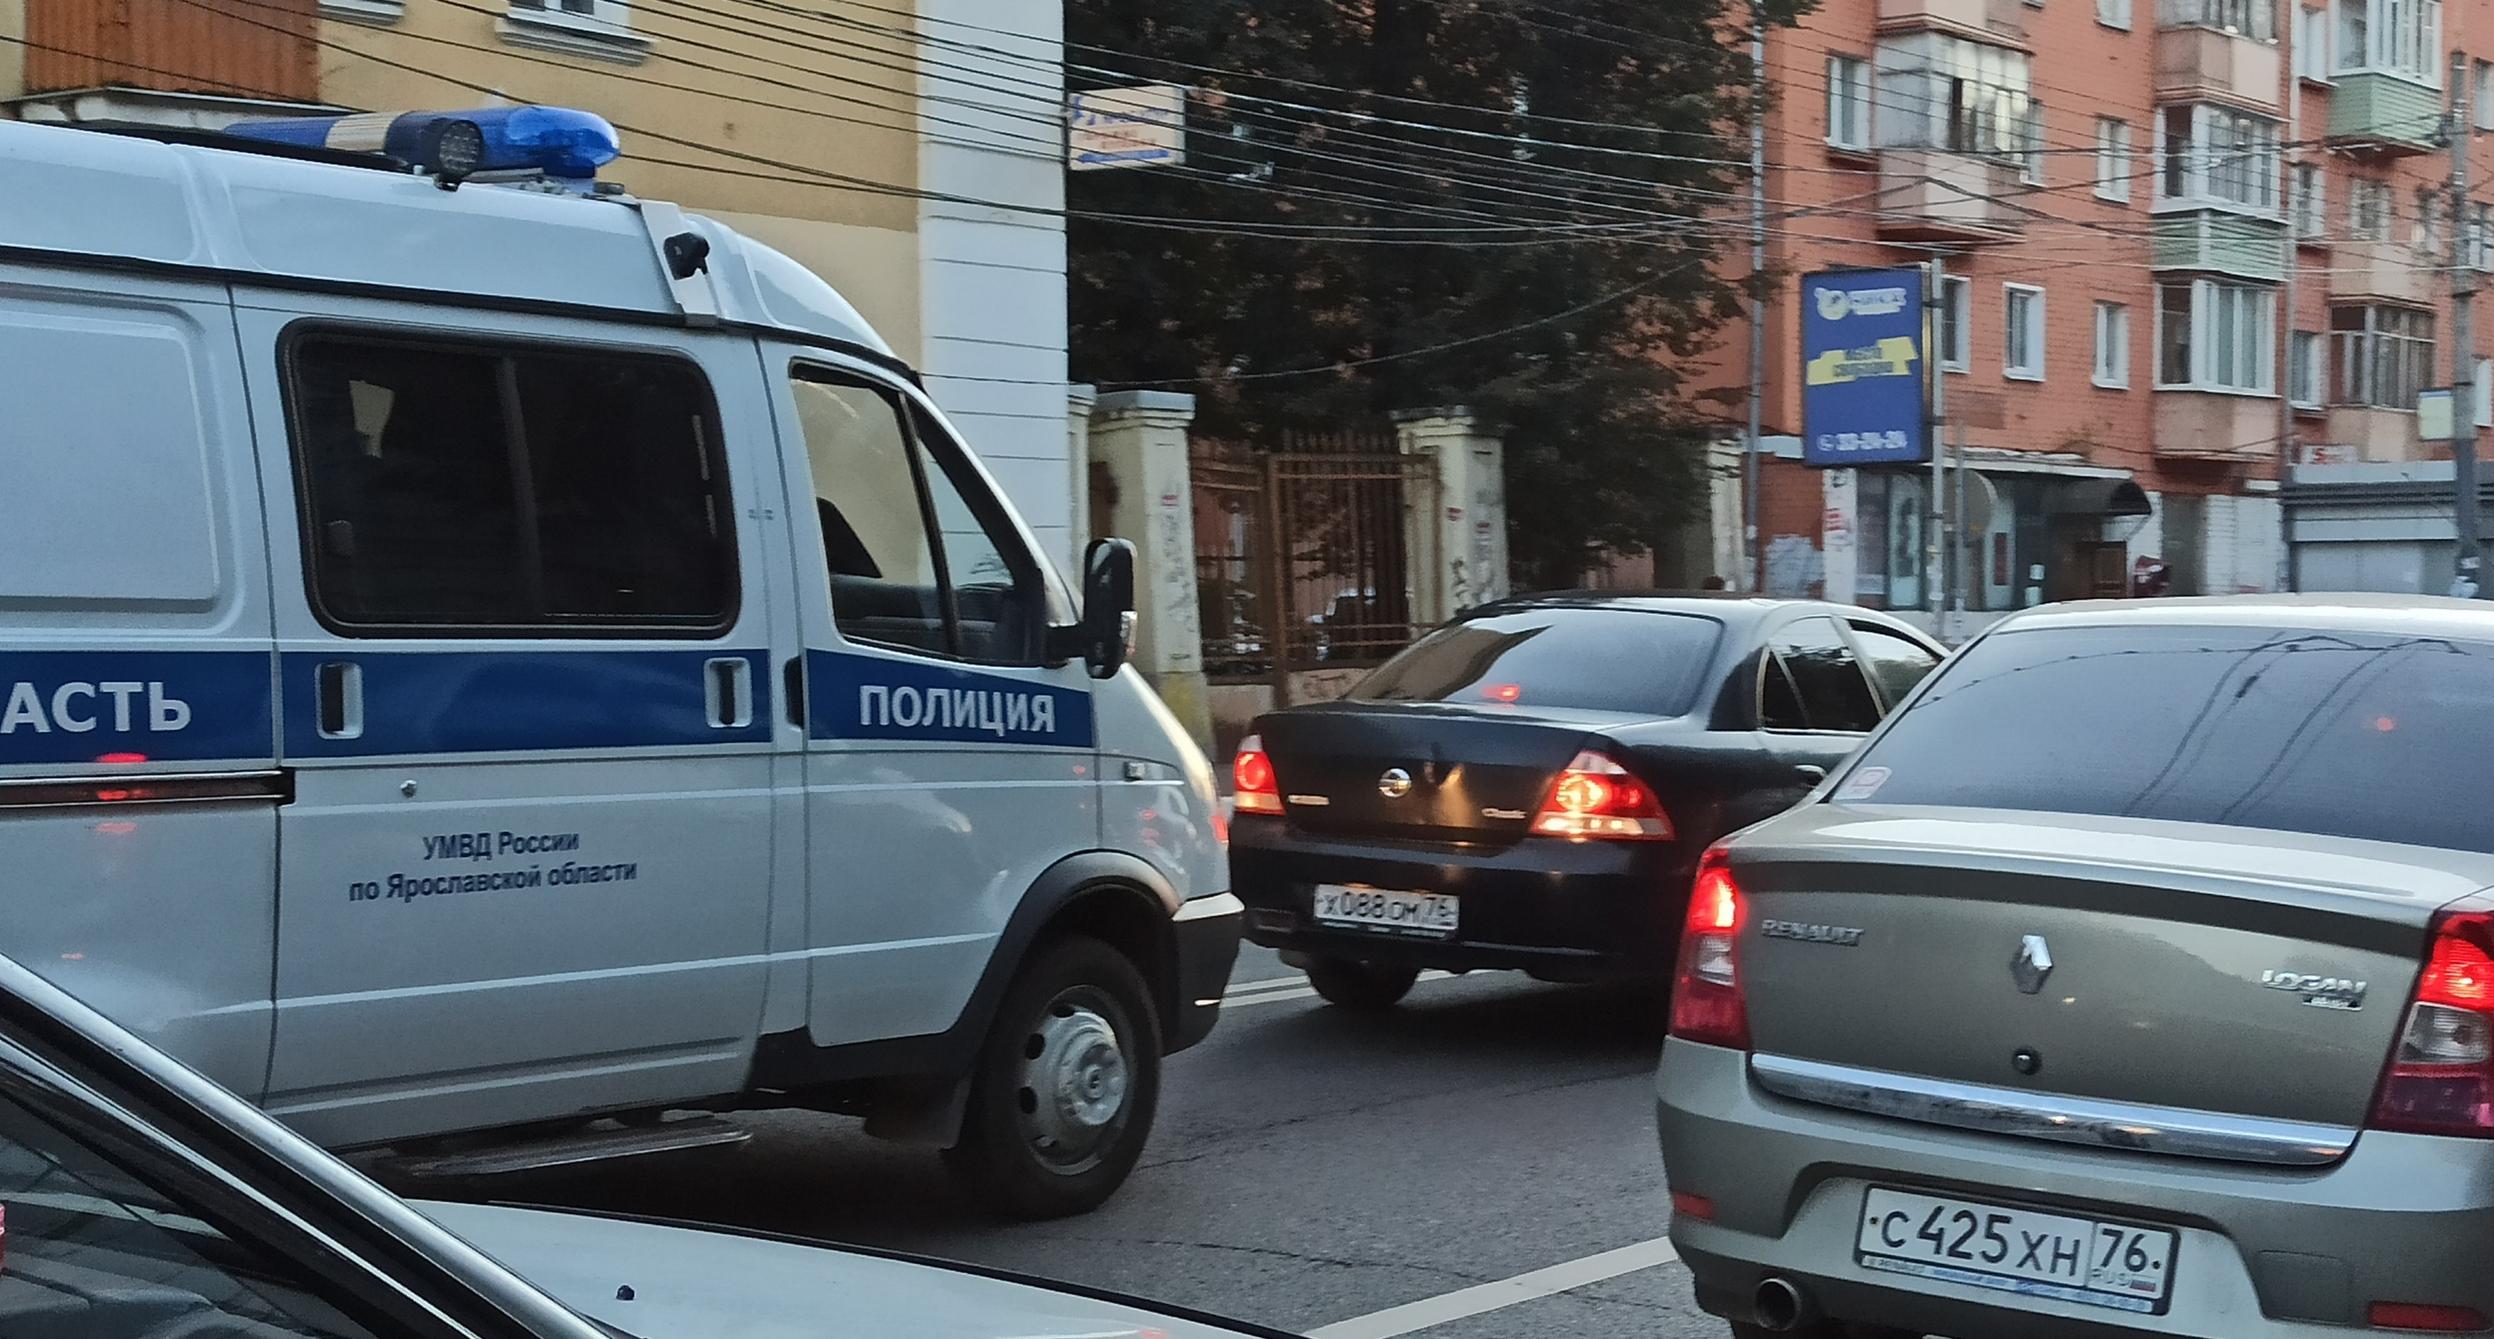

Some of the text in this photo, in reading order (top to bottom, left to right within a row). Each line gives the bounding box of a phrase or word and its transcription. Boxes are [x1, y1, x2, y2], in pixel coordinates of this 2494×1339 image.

[0, 681, 192, 734] АСТЬ
[859, 685, 1056, 736] ПОЛИЦИЯ
[422, 831, 580, 861] УМВД России
[350, 861, 638, 903] по Ярославской области
[2262, 969, 2367, 996] LOGAN
[2101, 1227, 2147, 1272] 76
